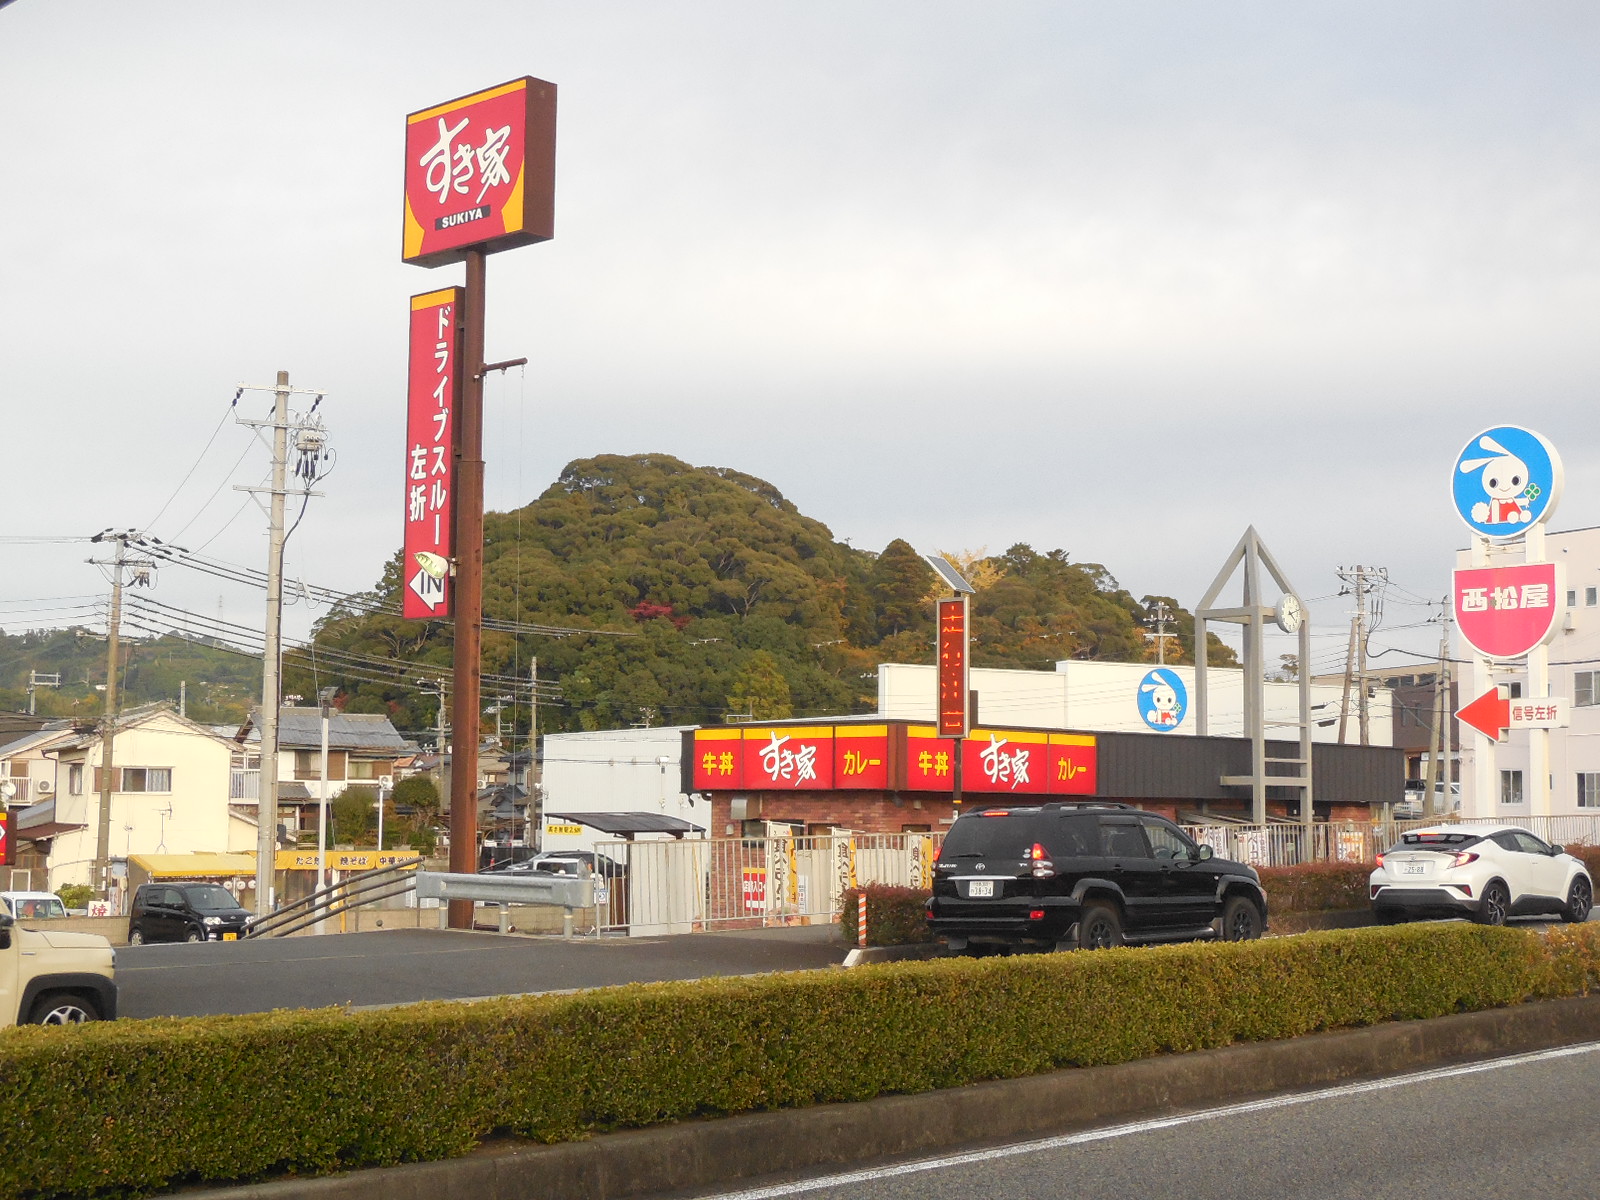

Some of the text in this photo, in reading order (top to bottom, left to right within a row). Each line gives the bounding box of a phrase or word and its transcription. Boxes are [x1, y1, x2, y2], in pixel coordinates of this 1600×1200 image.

[420, 117, 511, 205] すき家
[442, 207, 483, 228] SUKIYA
[430, 305, 451, 545] ドライブスルー
[410, 444, 428, 522] 左折
[421, 571, 442, 594] IN
[1461, 583, 1549, 612] 西松屋
[1513, 705, 1557, 721] 信号左折
[702, 752, 734, 776] 牛丼
[759, 730, 817, 787] すき家
[843, 749, 881, 776] カレー
[918, 750, 949, 777] 牛丼
[980, 733, 1030, 790] すき家
[1057, 756, 1088, 781] カレー
